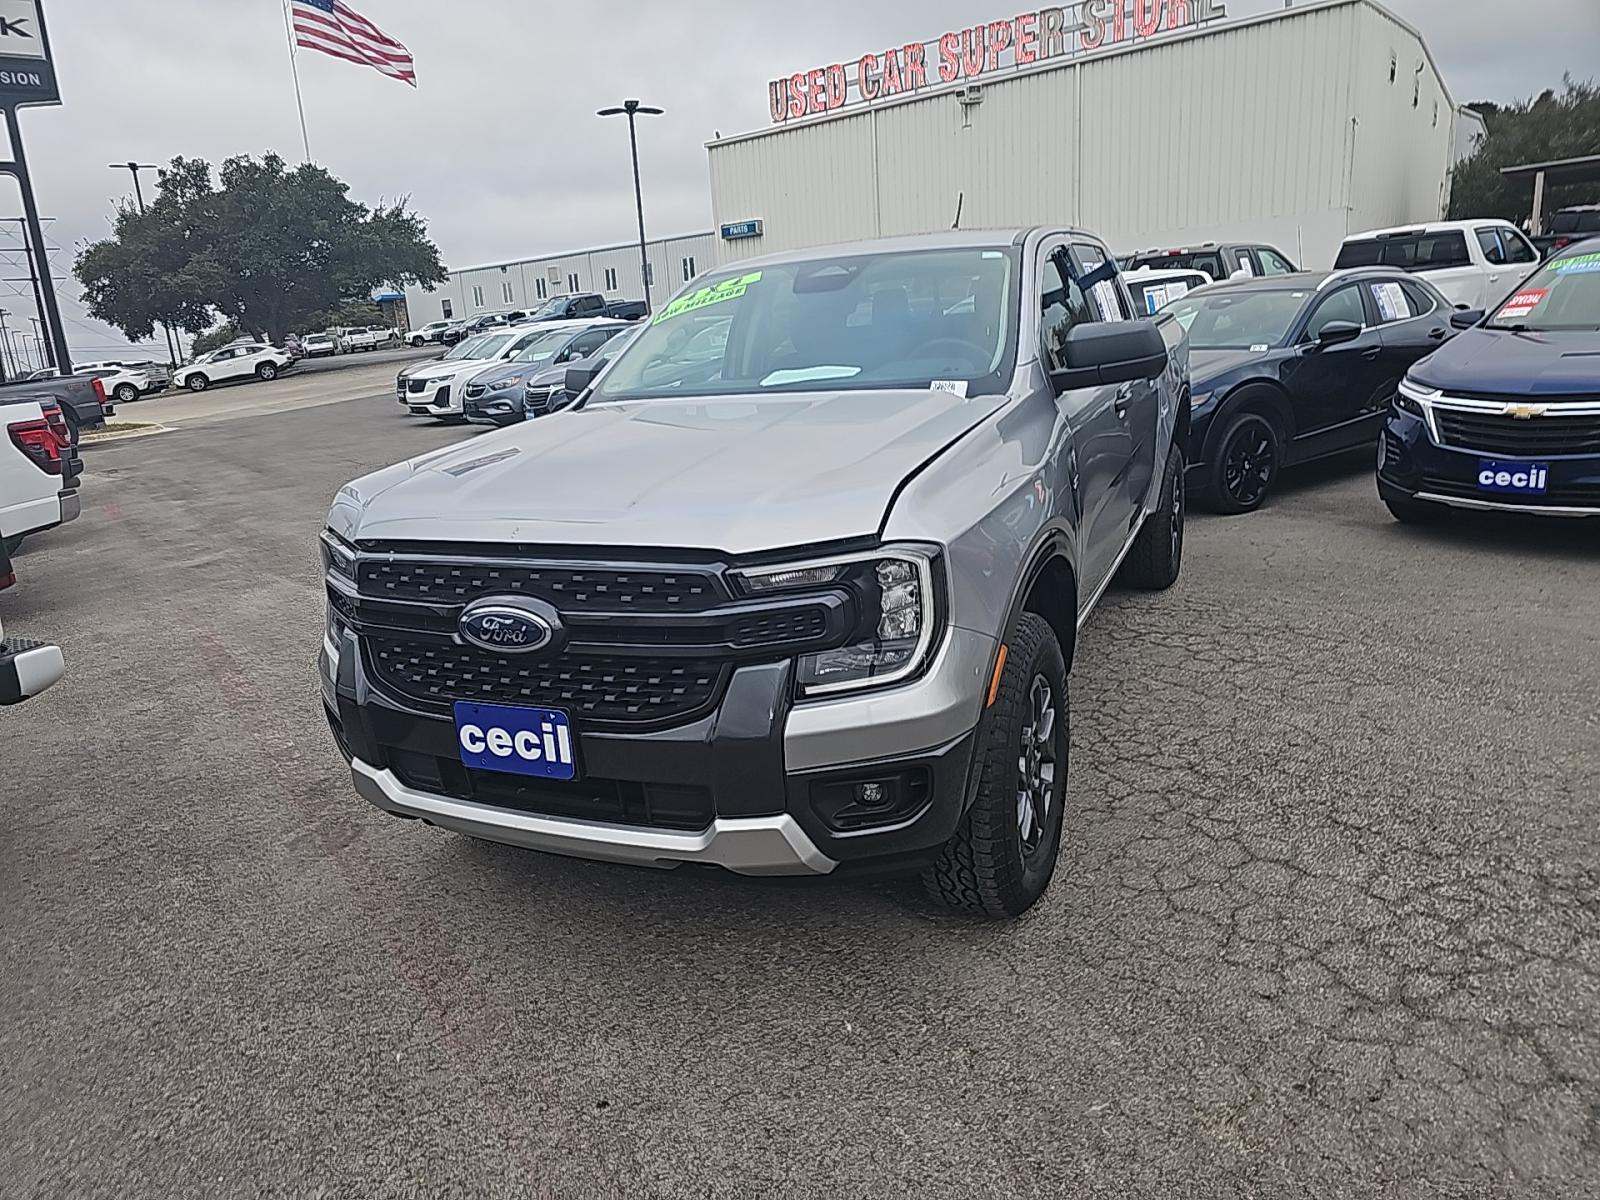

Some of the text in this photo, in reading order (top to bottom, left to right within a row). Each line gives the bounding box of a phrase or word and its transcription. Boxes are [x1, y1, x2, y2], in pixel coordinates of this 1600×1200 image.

[769, 64, 847, 121] USED
[858, 43, 928, 100] CAR
[938, 8, 1066, 82] SUPER
[729, 224, 749, 235] PARTS
[1478, 468, 1547, 489] cecil
[479, 616, 528, 643] Ford
[459, 722, 572, 764] cecil
